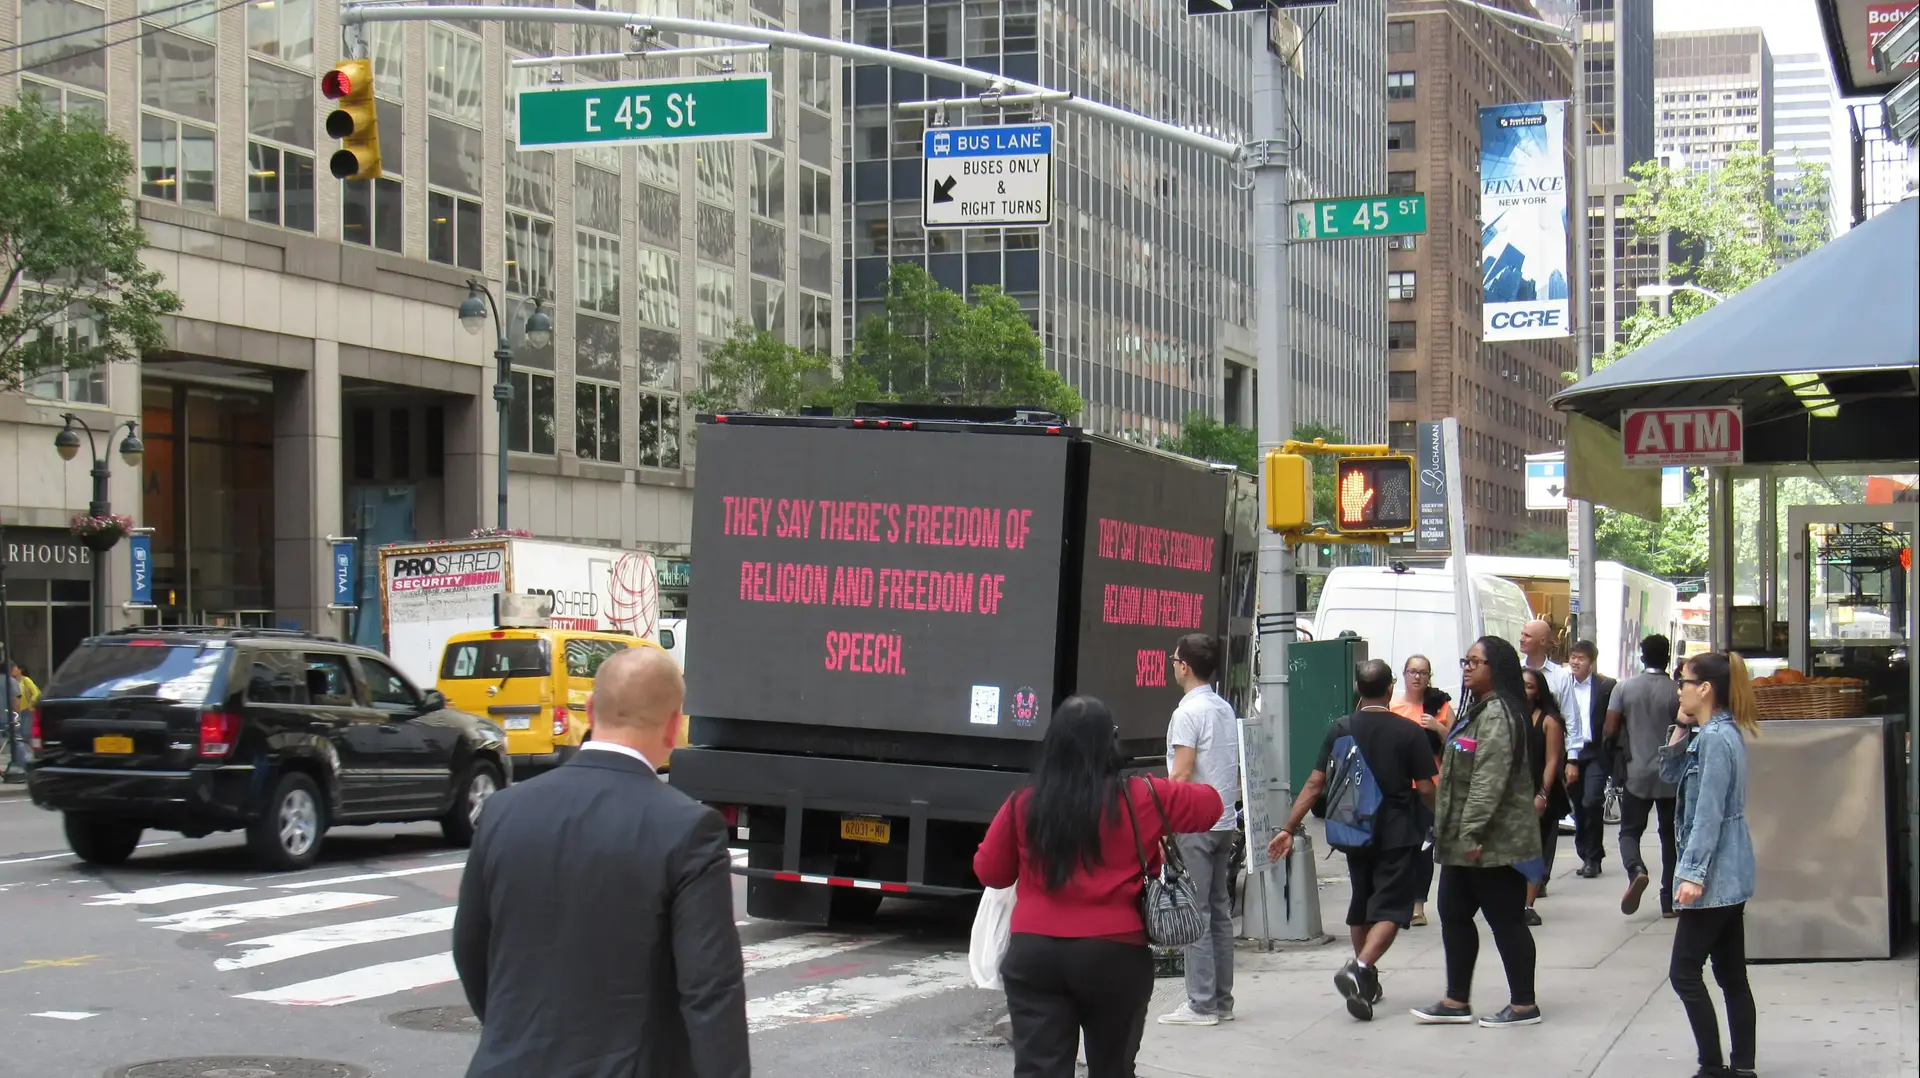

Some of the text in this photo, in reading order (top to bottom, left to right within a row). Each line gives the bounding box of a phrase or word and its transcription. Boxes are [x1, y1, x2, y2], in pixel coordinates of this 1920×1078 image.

[585, 92, 696, 132] E 45 St
[958, 134, 1041, 150] BUS LANE
[963, 159, 1040, 175] BUSES ONLY
[997, 180, 1006, 194] &
[1484, 176, 1563, 195] FINANCE
[961, 200, 1042, 216] RIGHT TURNS
[1322, 199, 1418, 233] E 45 ST
[1499, 198, 1520, 207] NEW
[1491, 310, 1560, 329] CCRE
[1637, 412, 1729, 452] ATM
[722, 496, 1033, 549] THEY SAY THERE'S FREEDOM OF
[9, 543, 90, 564] RHOUSE
[1099, 518, 1215, 572] THEY SAY THERE'S FREEDOM OF
[135, 561, 145, 590] TIAA
[394, 552, 501, 577] PROSHRED
[338, 566, 348, 593] TIAA
[395, 576, 462, 589] SECURITY
[740, 561, 1005, 615] RELIGION AND FREEDOM OF
[528, 588, 598, 616] OSHRED
[1104, 584, 1204, 628] RELIGION AND FREEDOM OF
[824, 630, 906, 675] SPEECH.
[1136, 649, 1166, 687] SPEECH.
